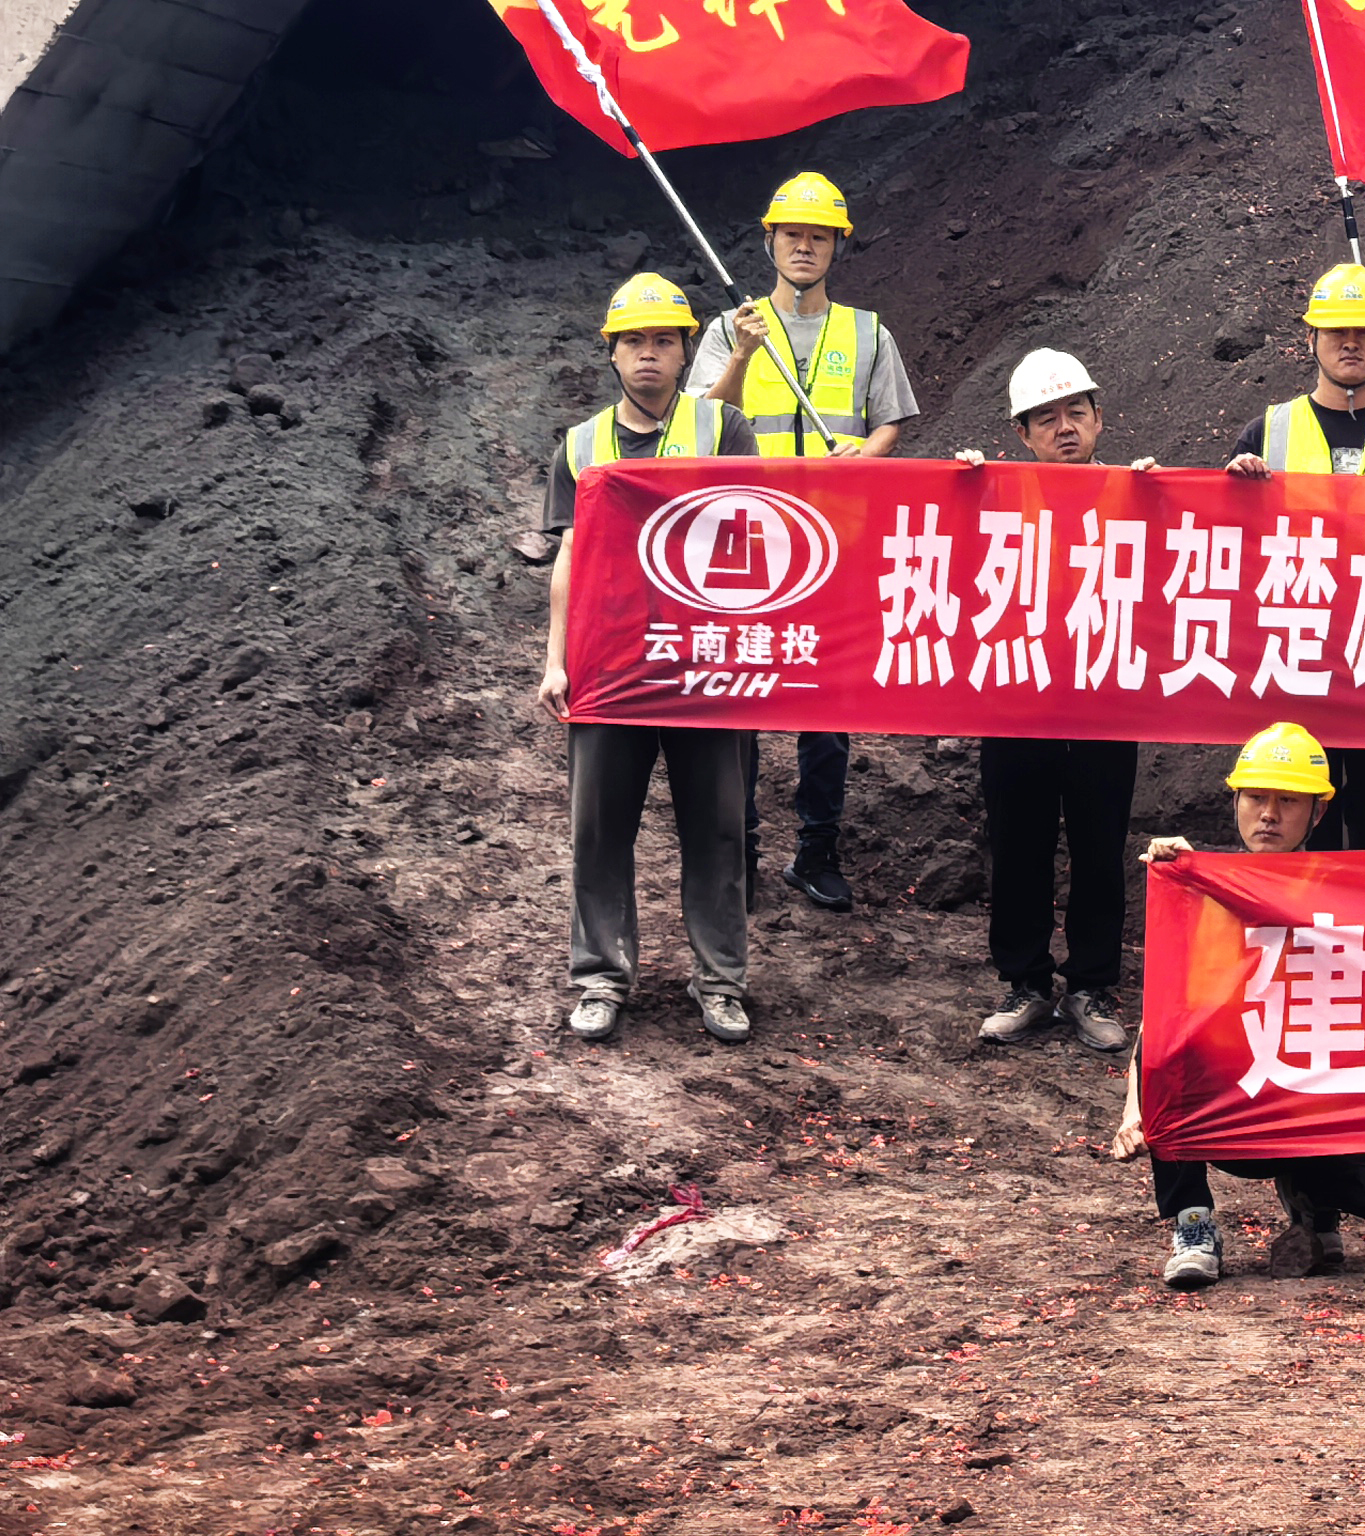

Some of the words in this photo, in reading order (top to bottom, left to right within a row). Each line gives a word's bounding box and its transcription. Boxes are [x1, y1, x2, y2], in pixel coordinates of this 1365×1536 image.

[644, 620, 821, 666] 云南建投
[680, 670, 781, 698] YCIH
